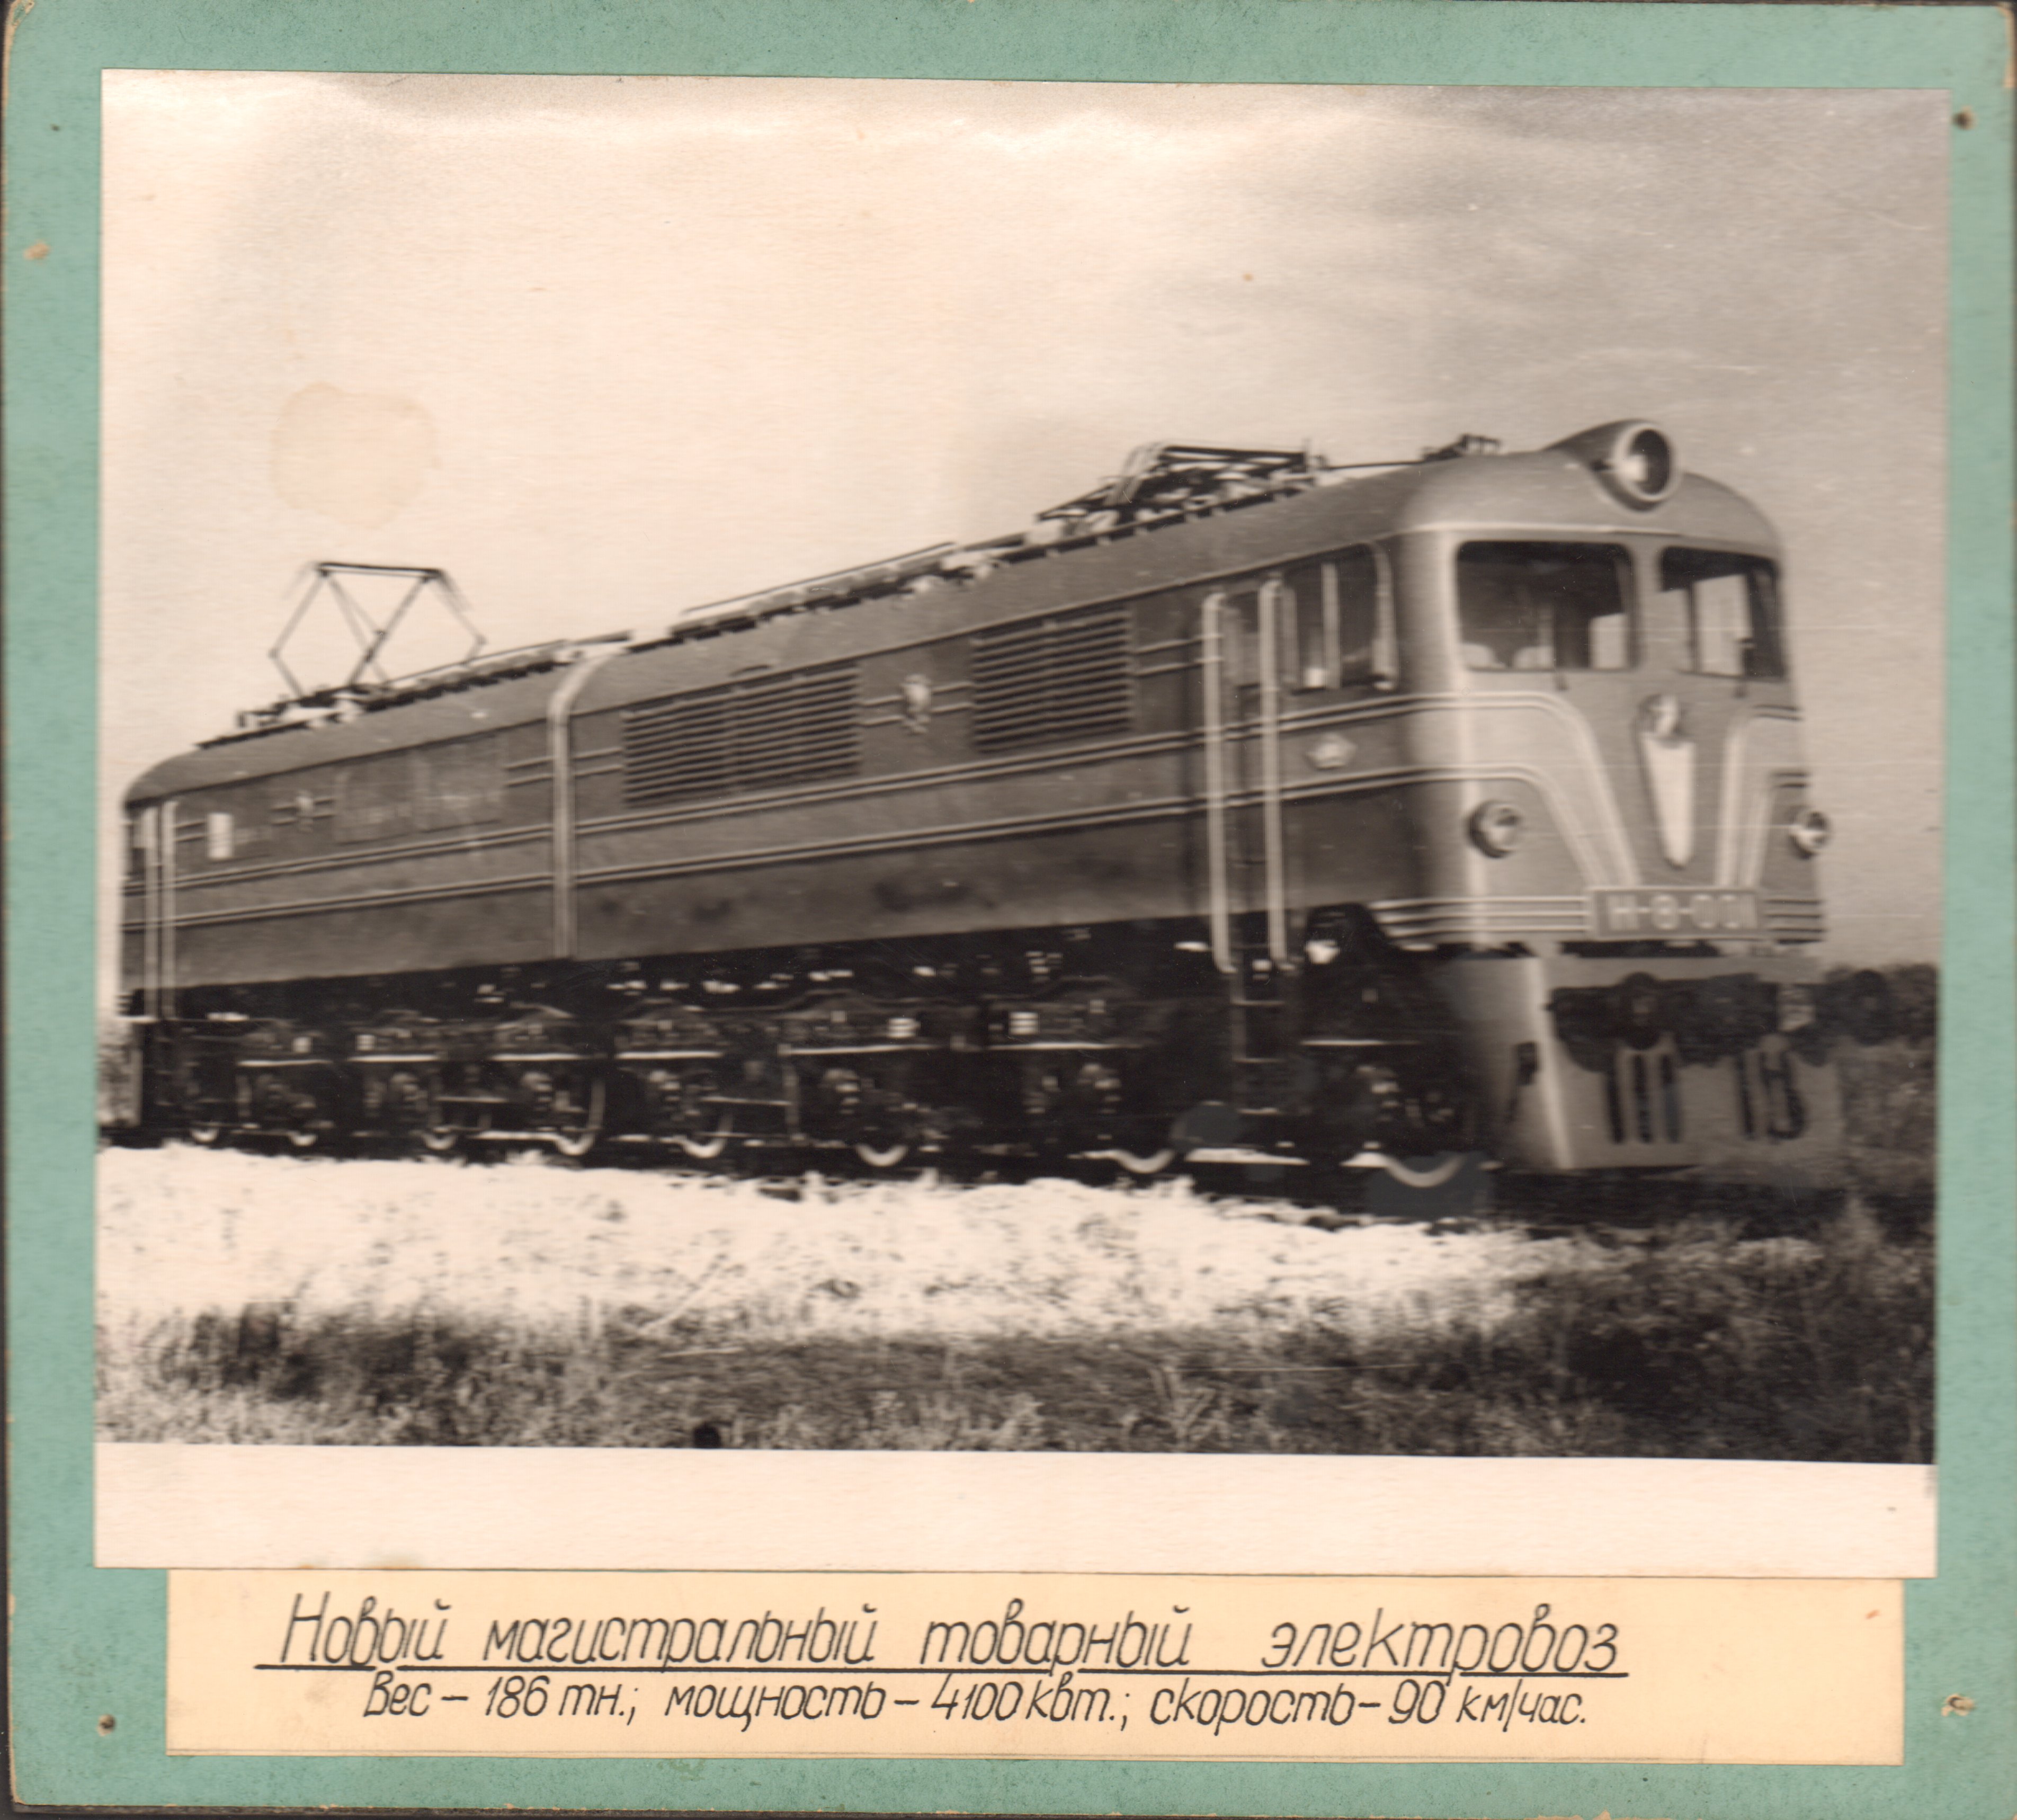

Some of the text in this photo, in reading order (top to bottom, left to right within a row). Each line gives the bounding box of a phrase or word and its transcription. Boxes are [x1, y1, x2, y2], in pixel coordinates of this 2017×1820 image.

[281, 1591, 1619, 1686] Новый магистральный товарный электровоз
[558, 1683, 639, 1726] тн.;
[1455, 1679, 1587, 1733] км/час.
